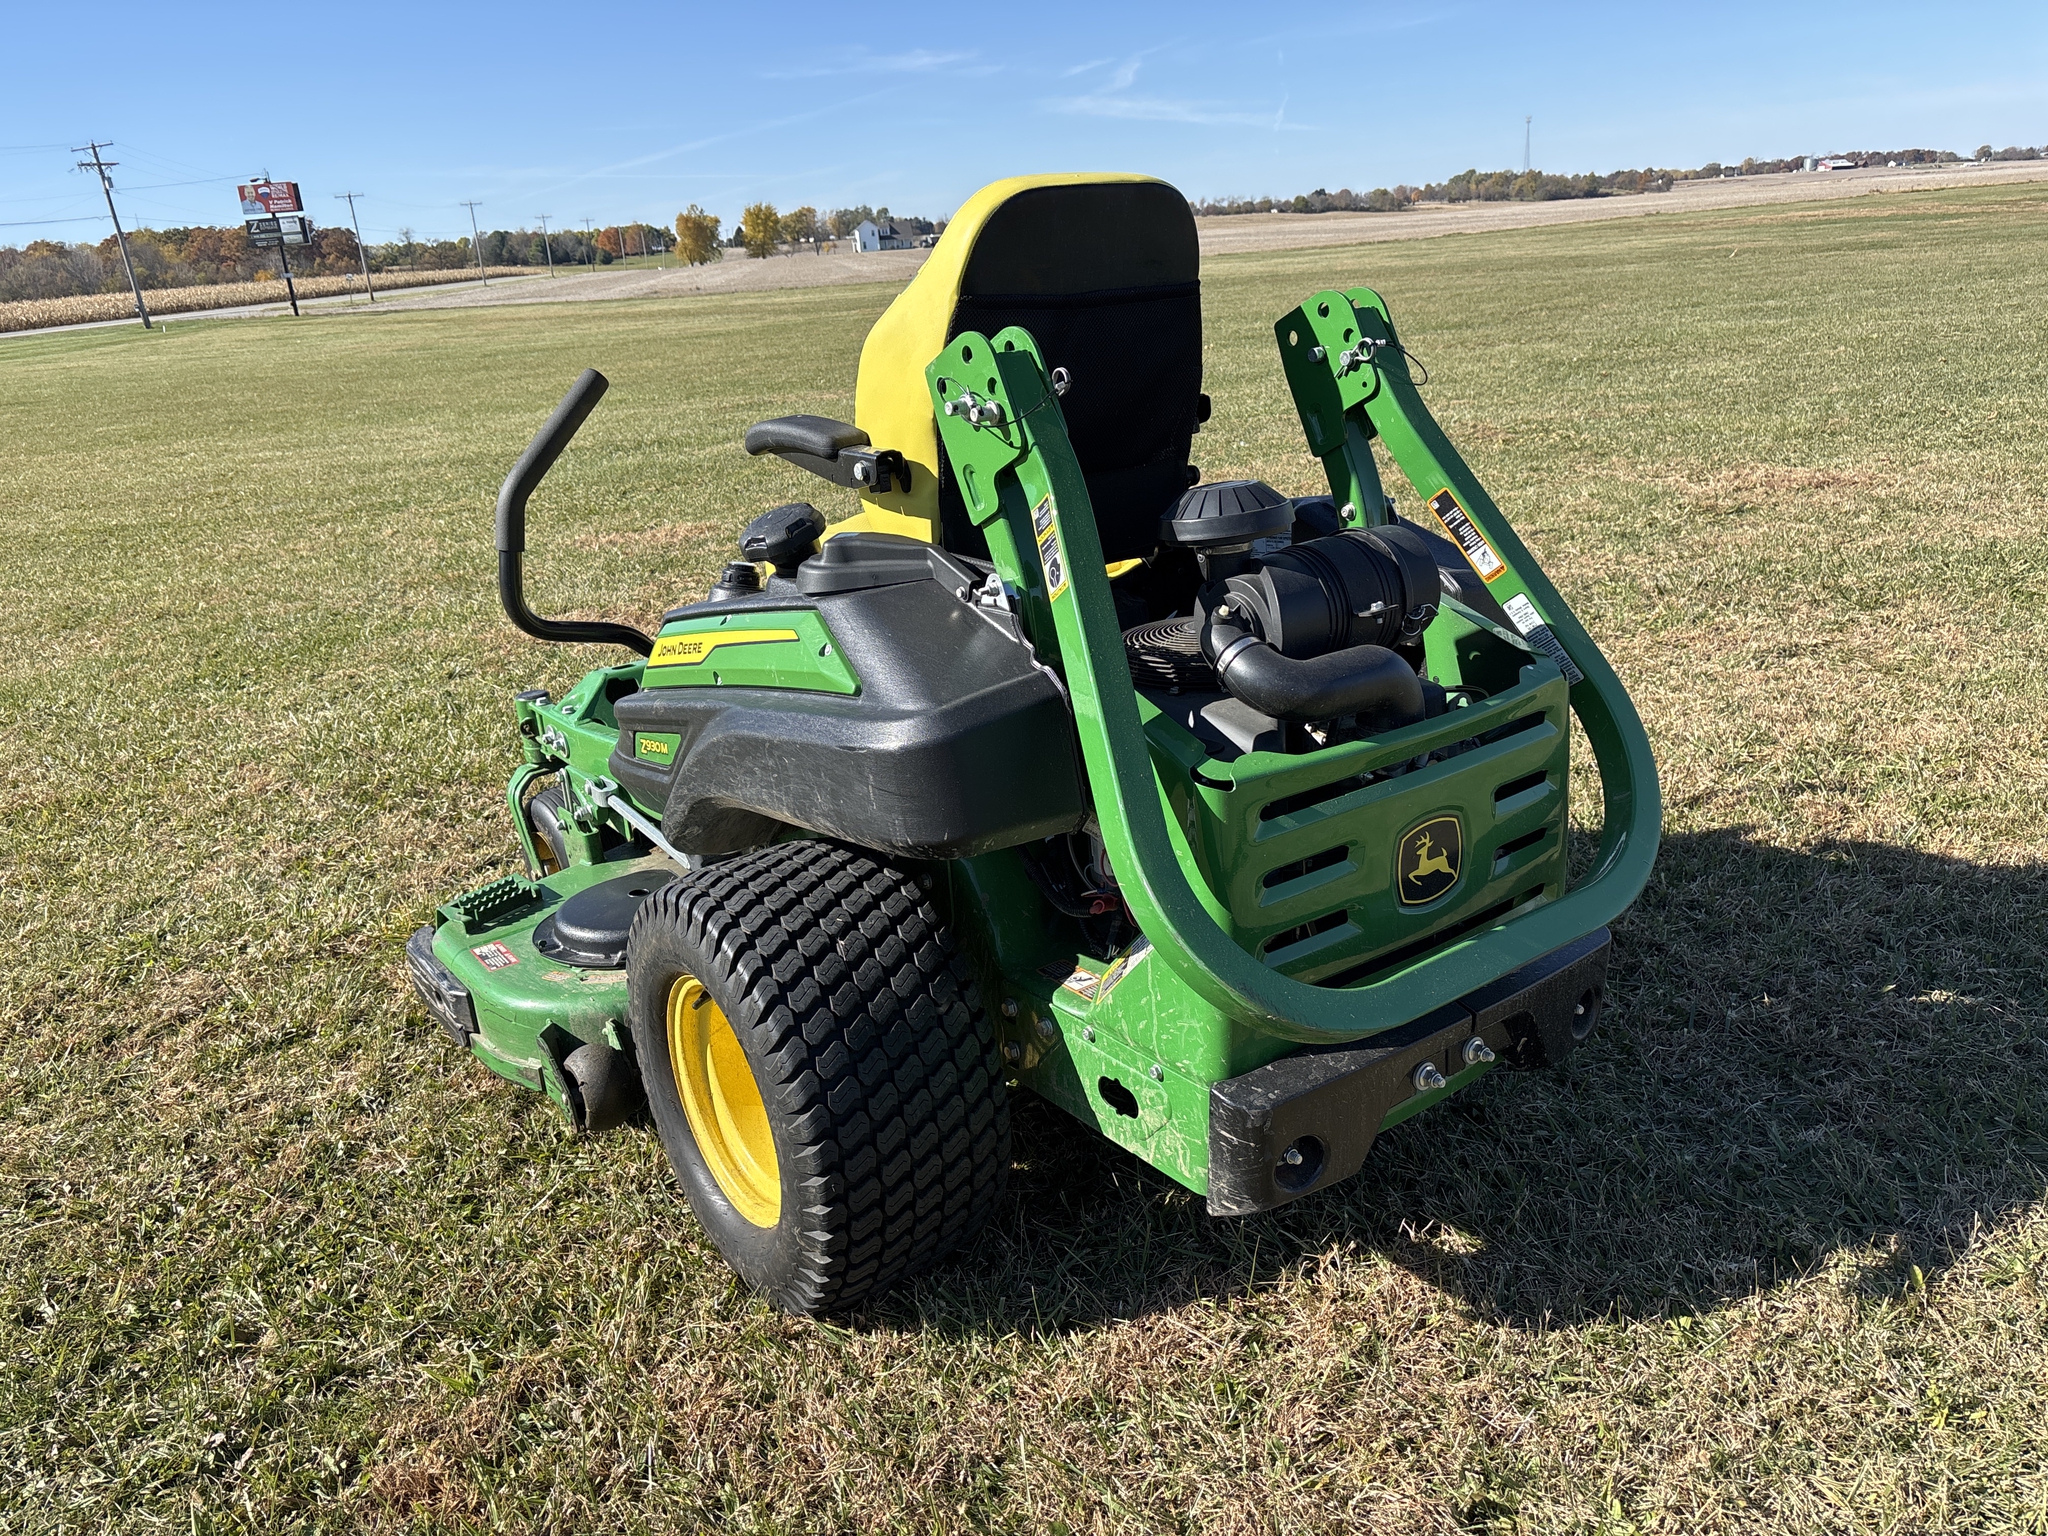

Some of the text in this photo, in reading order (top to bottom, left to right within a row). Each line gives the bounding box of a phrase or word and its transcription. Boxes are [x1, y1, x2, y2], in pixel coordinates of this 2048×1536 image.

[658, 642, 703, 657] JOHN DEERE
[640, 738, 669, 755] Z930M
